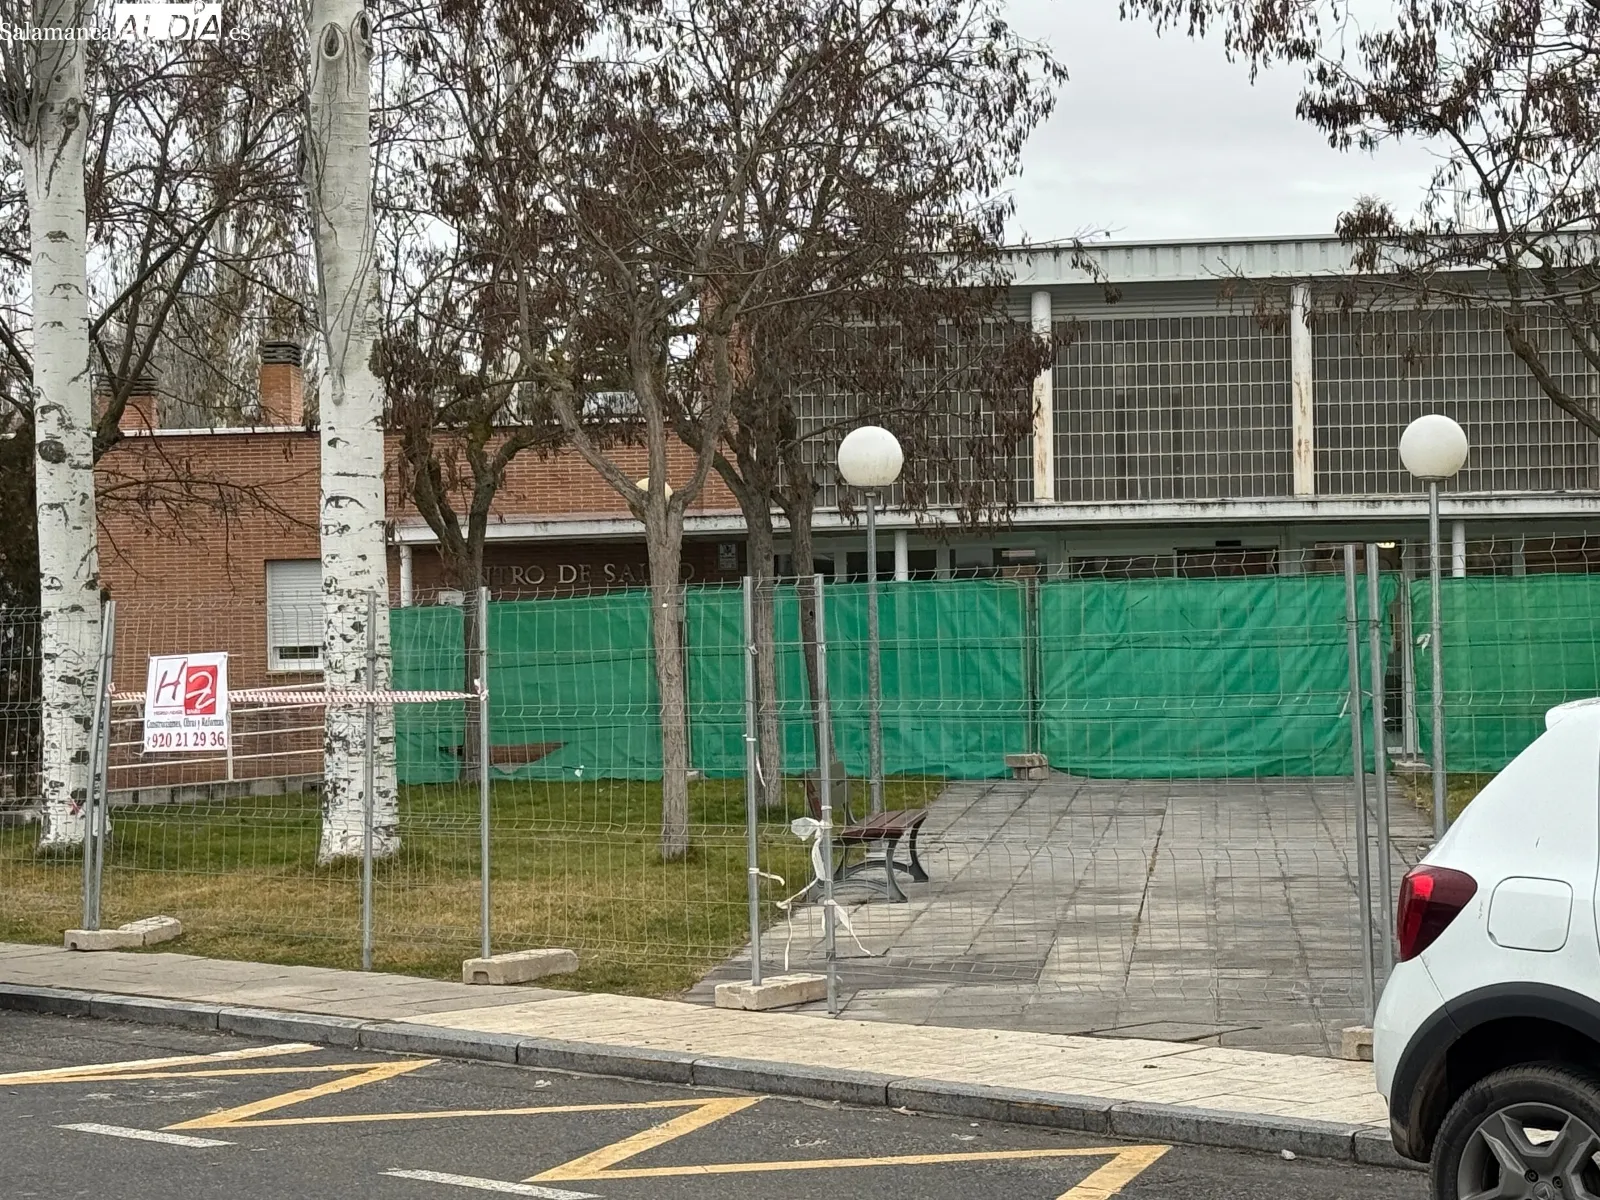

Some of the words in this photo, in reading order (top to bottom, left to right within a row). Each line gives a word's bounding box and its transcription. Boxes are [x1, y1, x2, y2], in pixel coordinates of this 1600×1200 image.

[474, 563, 545, 586] NTRO
[558, 563, 592, 584] DE
[604, 562, 695, 584] SALD
[201, 717, 225, 727] Reformas
[152, 733, 172, 748] 920
[175, 732, 188, 747] 21
[193, 731, 206, 746] 29
[210, 730, 225, 746] 36
